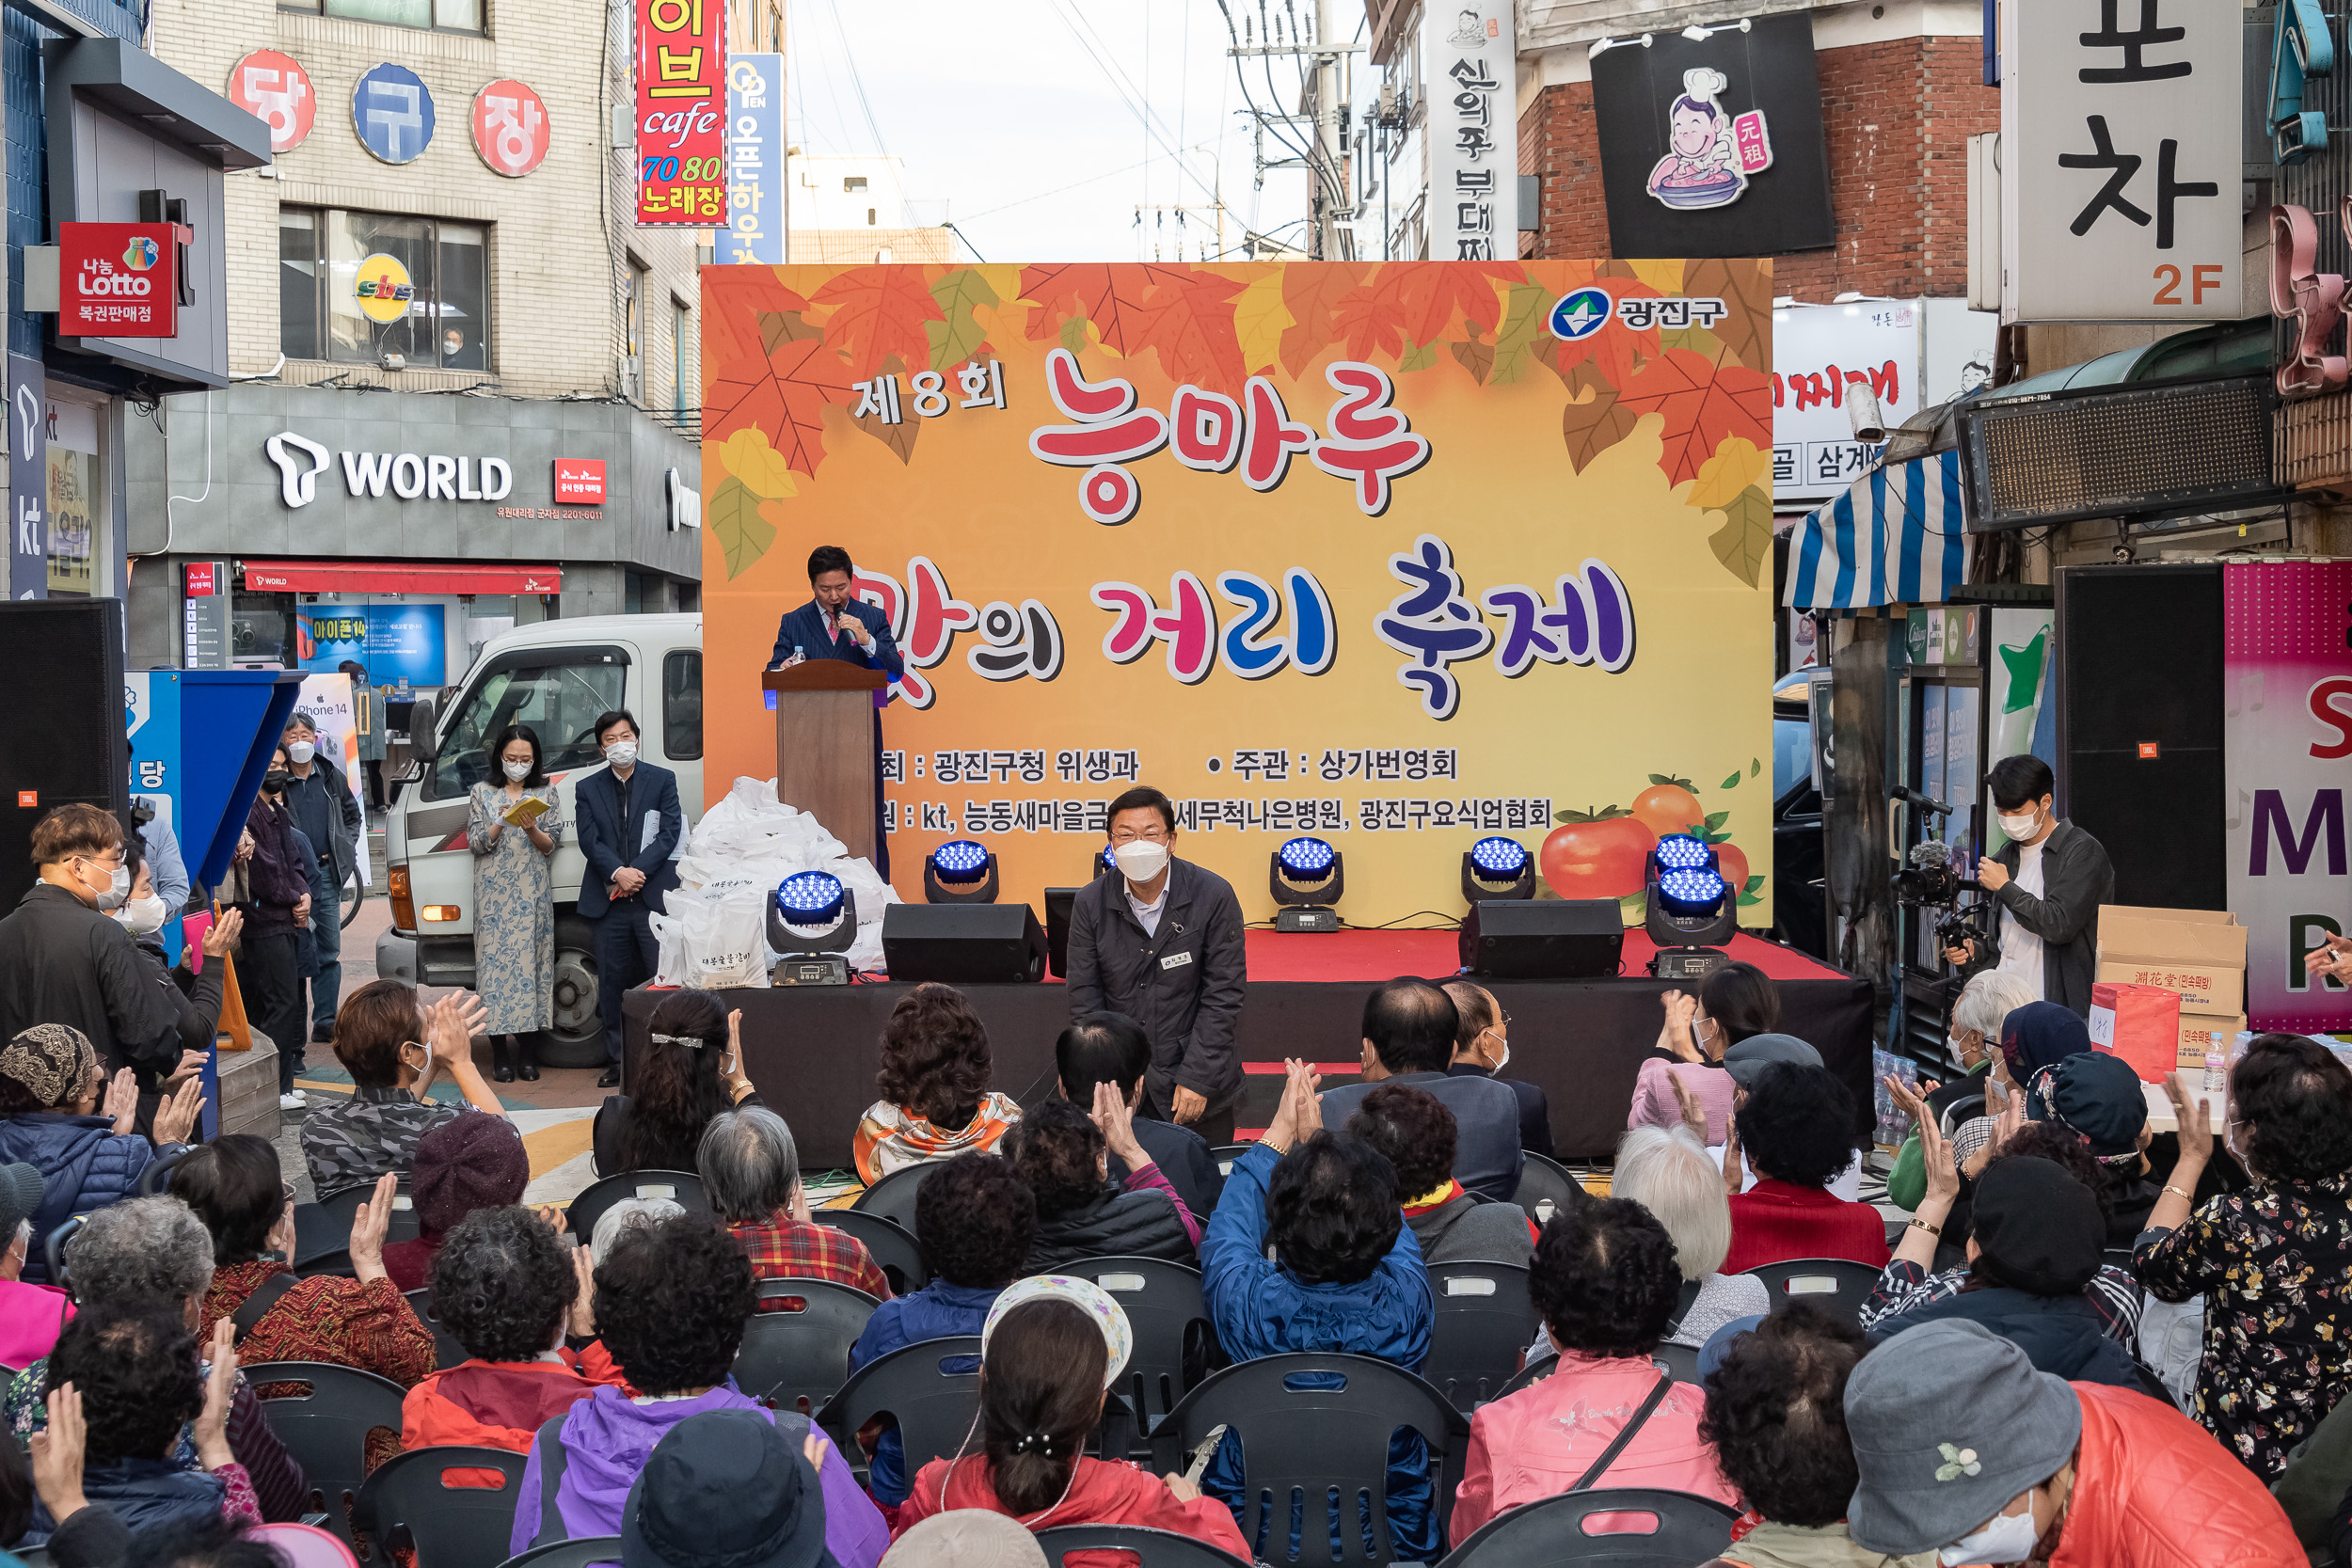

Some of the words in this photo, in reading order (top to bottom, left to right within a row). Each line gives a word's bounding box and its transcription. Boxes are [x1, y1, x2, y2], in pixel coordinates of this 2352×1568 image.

[644, 102, 719, 148] cafe
[1740, 121, 1765, 165] 元祖
[643, 186, 724, 216] 노래장
[83, 259, 114, 275] 나눔
[78, 273, 151, 295] Lotto
[2153, 264, 2223, 305] 2F
[79, 306, 151, 323] 복권판매점
[1618, 297, 1728, 329] 광진구
[1029, 348, 1431, 526] 능마루
[342, 451, 513, 501] WORLD
[1818, 444, 1884, 479] 삼계
[19, 495, 41, 556] kt
[563, 509, 603, 521] 2201-6011
[265, 578, 287, 586] WORLD
[1089, 567, 1337, 684] 거리
[1373, 532, 1636, 721] 축제
[294, 705, 334, 716] iPhone
[335, 704, 347, 715] 14
[935, 750, 1047, 783] 광진구청
[1057, 750, 1139, 783] 위생과
[1233, 750, 1289, 781] 주관
[1319, 749, 1457, 781] 상가번영회
[22, 795, 35, 803] JBL
[1169, 799, 1351, 832] 세무척나은병원,
[1359, 799, 1552, 831] 광진구요식업협회
